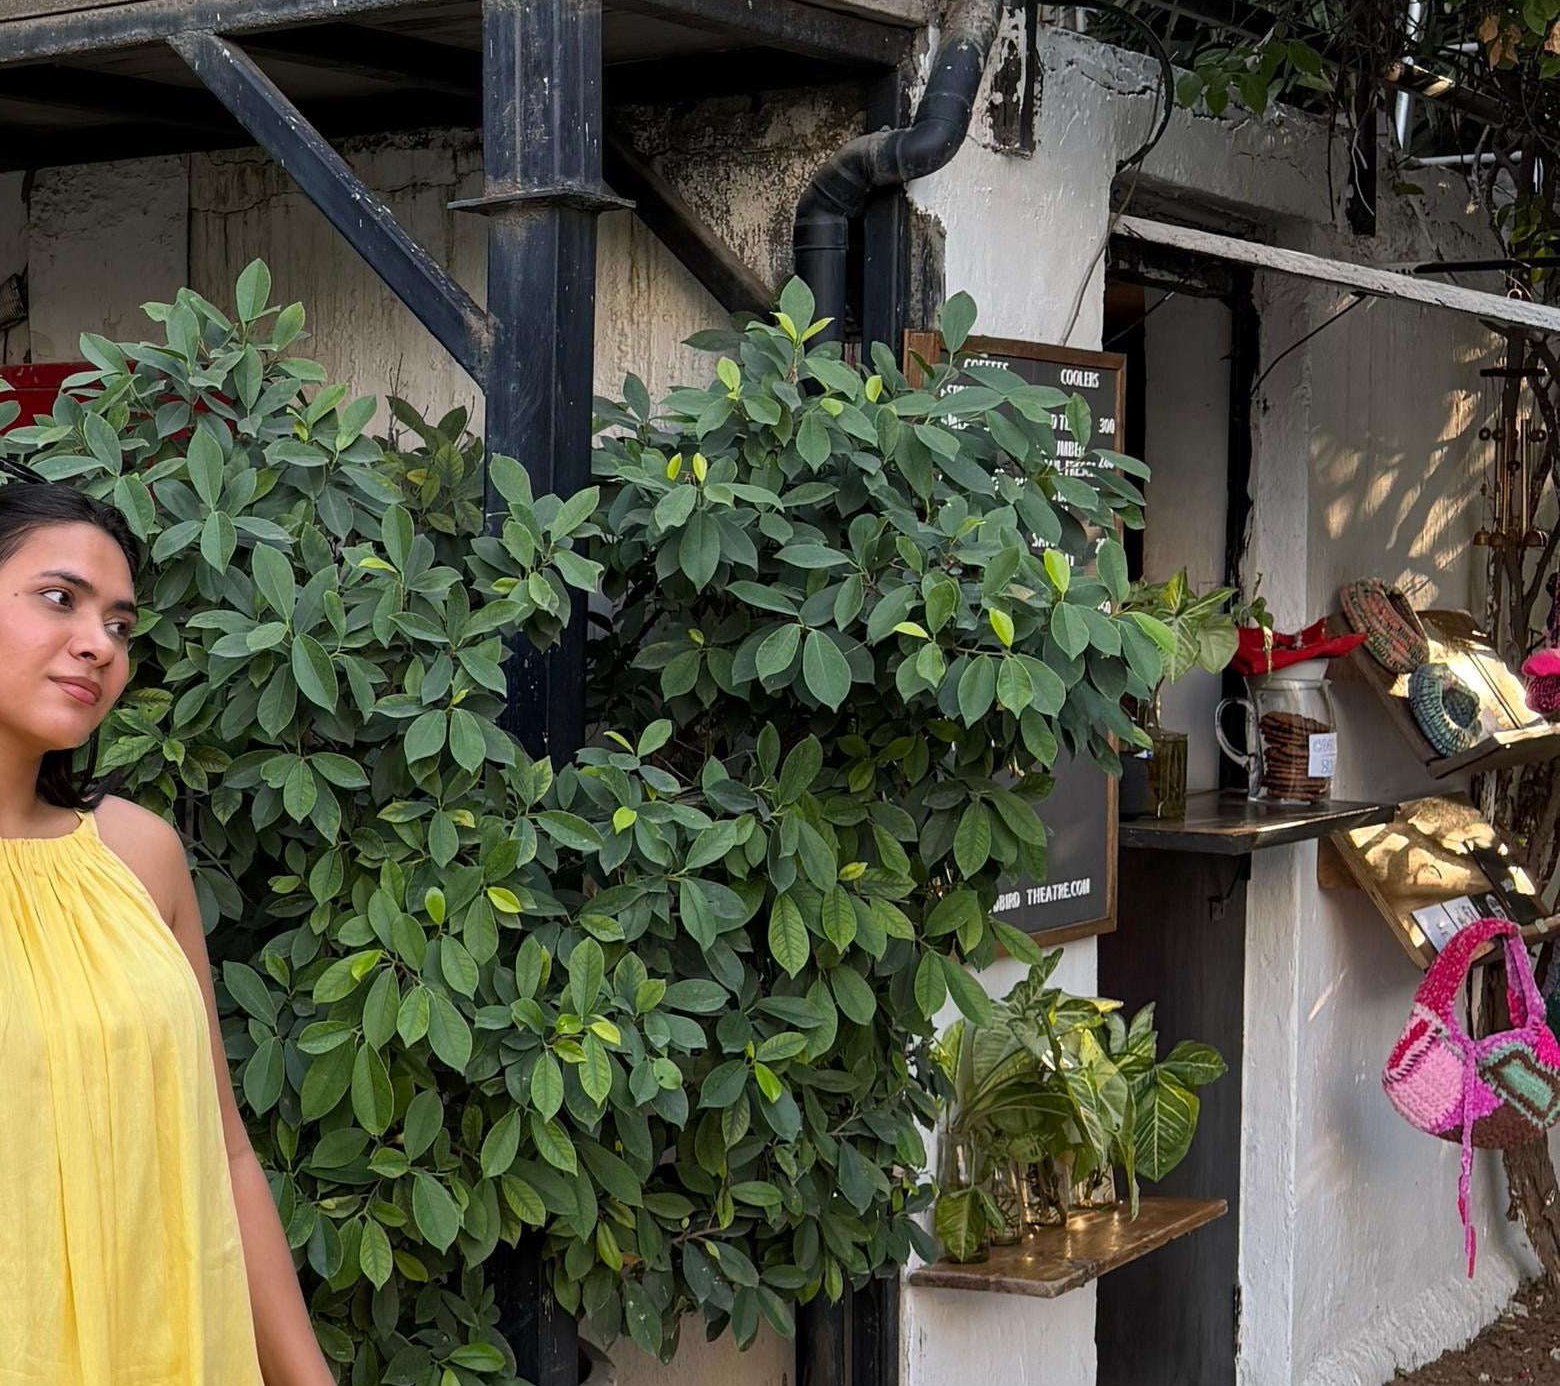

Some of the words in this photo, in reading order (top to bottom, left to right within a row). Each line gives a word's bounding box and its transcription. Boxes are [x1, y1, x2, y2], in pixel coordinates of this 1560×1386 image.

[1060, 368, 1100, 388] COOLERS
[1098, 417, 1116, 434] 300
[1026, 878, 1091, 905] THEATRE.COM
